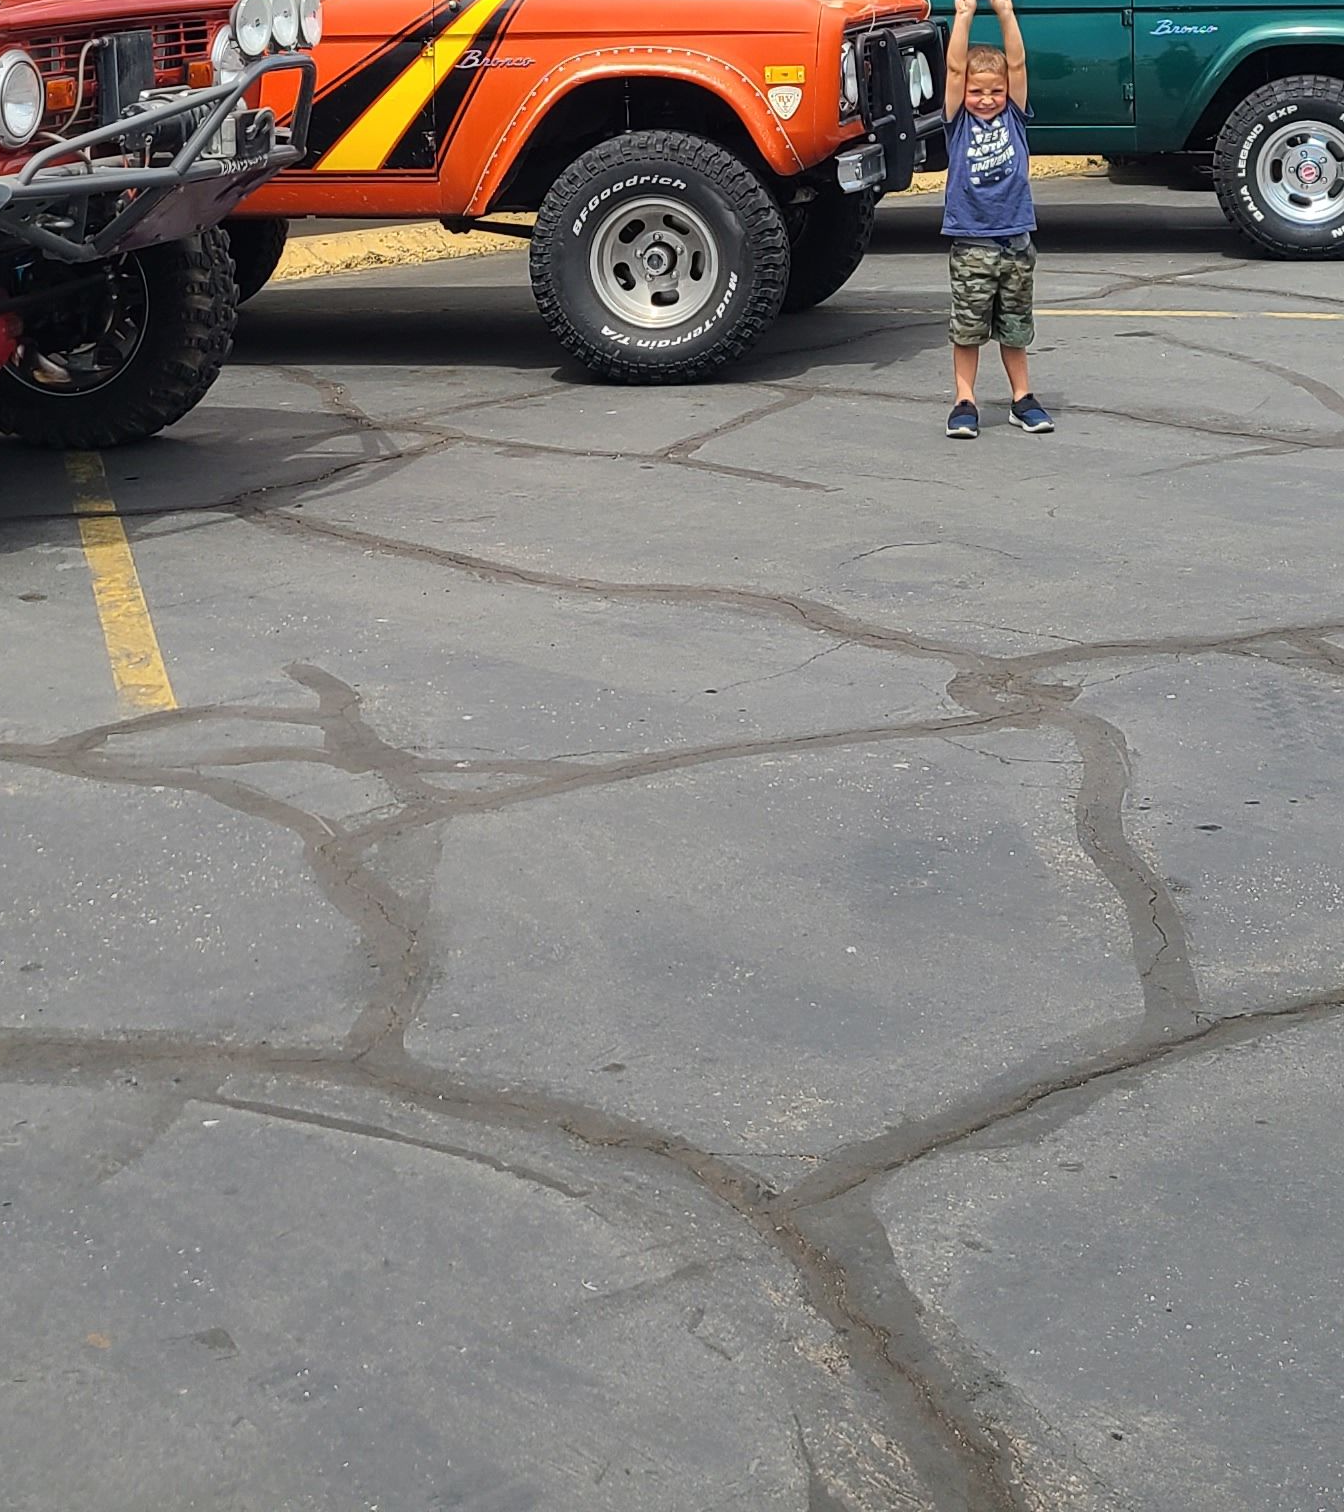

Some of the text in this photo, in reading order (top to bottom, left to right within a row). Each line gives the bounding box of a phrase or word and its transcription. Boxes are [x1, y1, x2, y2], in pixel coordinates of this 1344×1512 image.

[454, 49, 536, 69] Bronco
[1149, 19, 1218, 36] Bronco
[1237, 104, 1298, 223] BAJA LEGEND EXP
[572, 174, 687, 237] BFGoodrich
[600, 271, 739, 350] Mud-Terrain T/A
